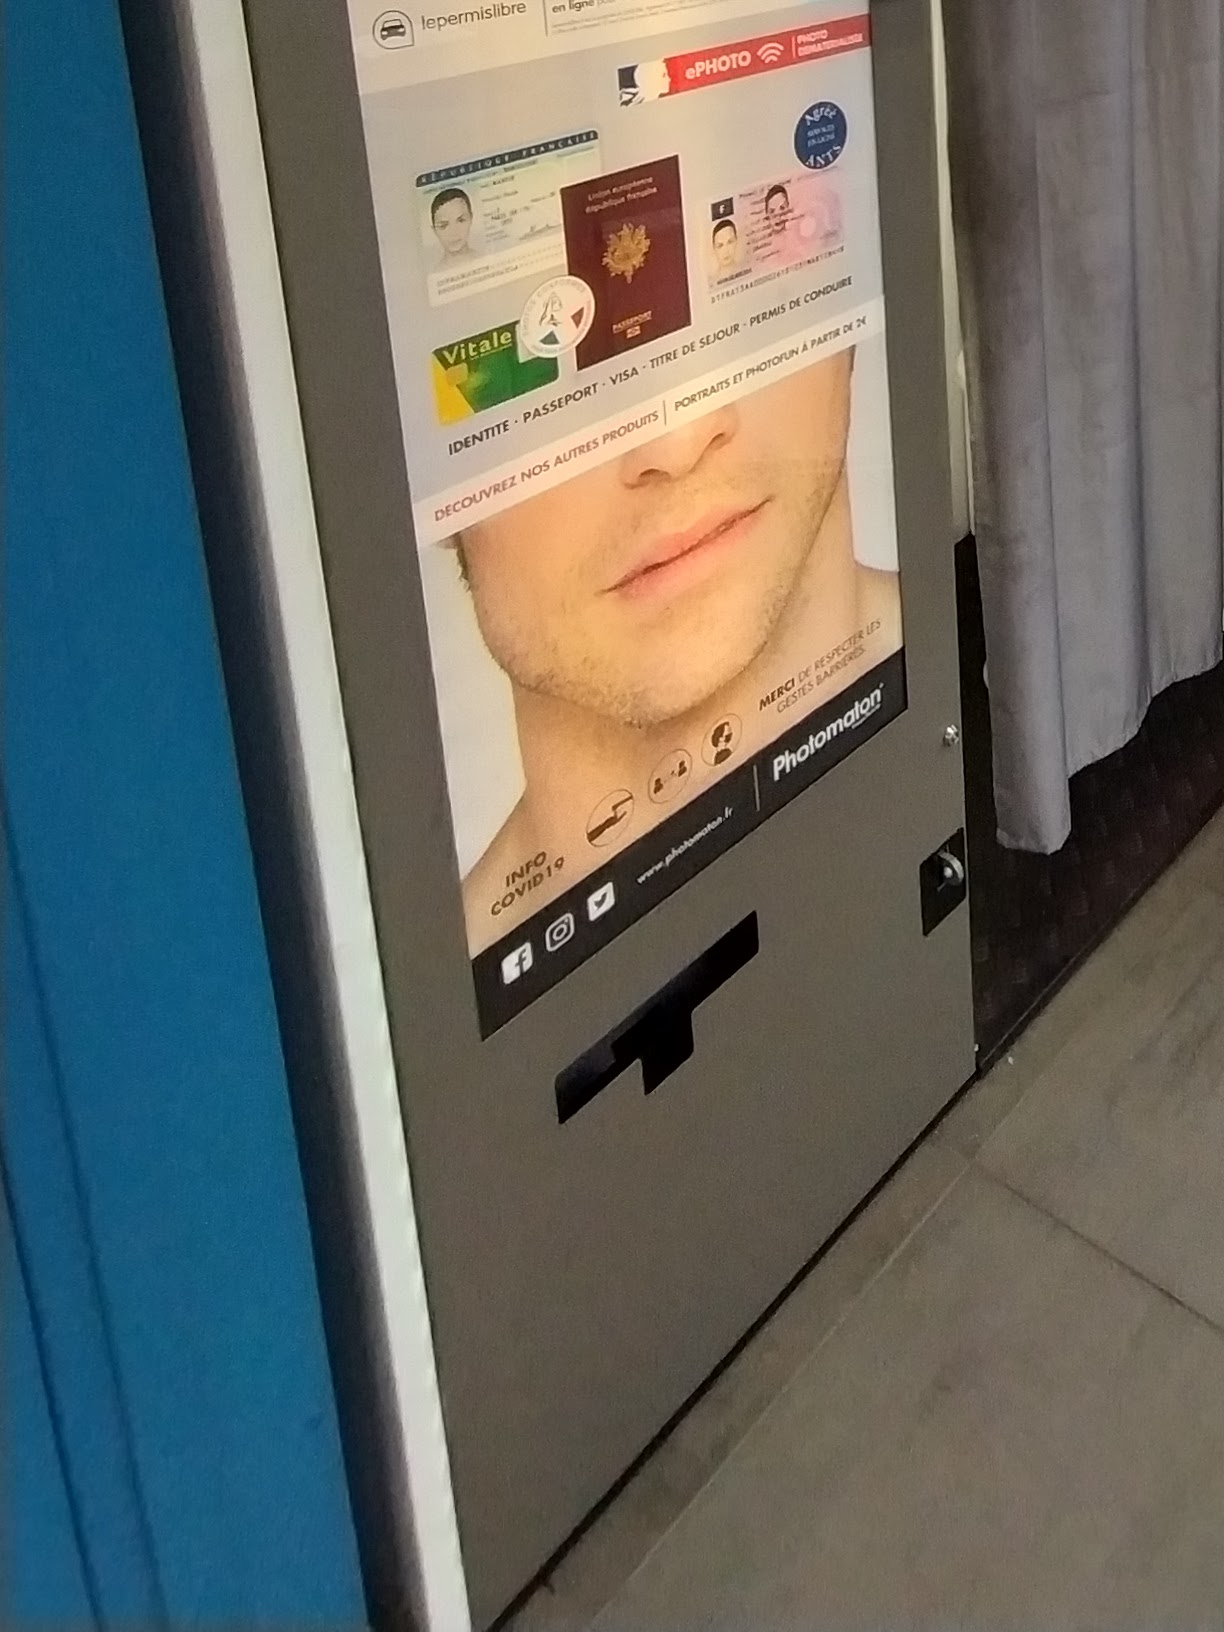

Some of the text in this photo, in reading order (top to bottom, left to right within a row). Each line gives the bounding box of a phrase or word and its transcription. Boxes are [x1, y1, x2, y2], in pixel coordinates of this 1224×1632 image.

[421, 0, 527, 31] lepermislibre
[552, 3, 566, 14] en
[685, 50, 752, 80] ePHOTO
[443, 329, 512, 365] Vitale
[448, 275, 853, 456] IDENTITE PASSEPORT VISA TITRE DE SEJOUR PERMIS DE CONDUIRE
[435, 475, 517, 522] DECOUVREZ
[521, 460, 551, 483] NOS
[554, 437, 600, 468] AUTRES
[602, 410, 660, 445] PRODUITS
[674, 377, 731, 412] PORTRAITS
[733, 371, 744, 385] ET
[746, 346, 799, 379] PHOTOFUN
[811, 327, 841, 350] PARTIR
[843, 321, 853, 334] DE
[759, 620, 881, 712] MERCI DE RESPECTER LES
[777, 680, 814, 714] GESTES
[636, 805, 734, 885] www.photomaton.fr
[505, 850, 547, 888] INFO
